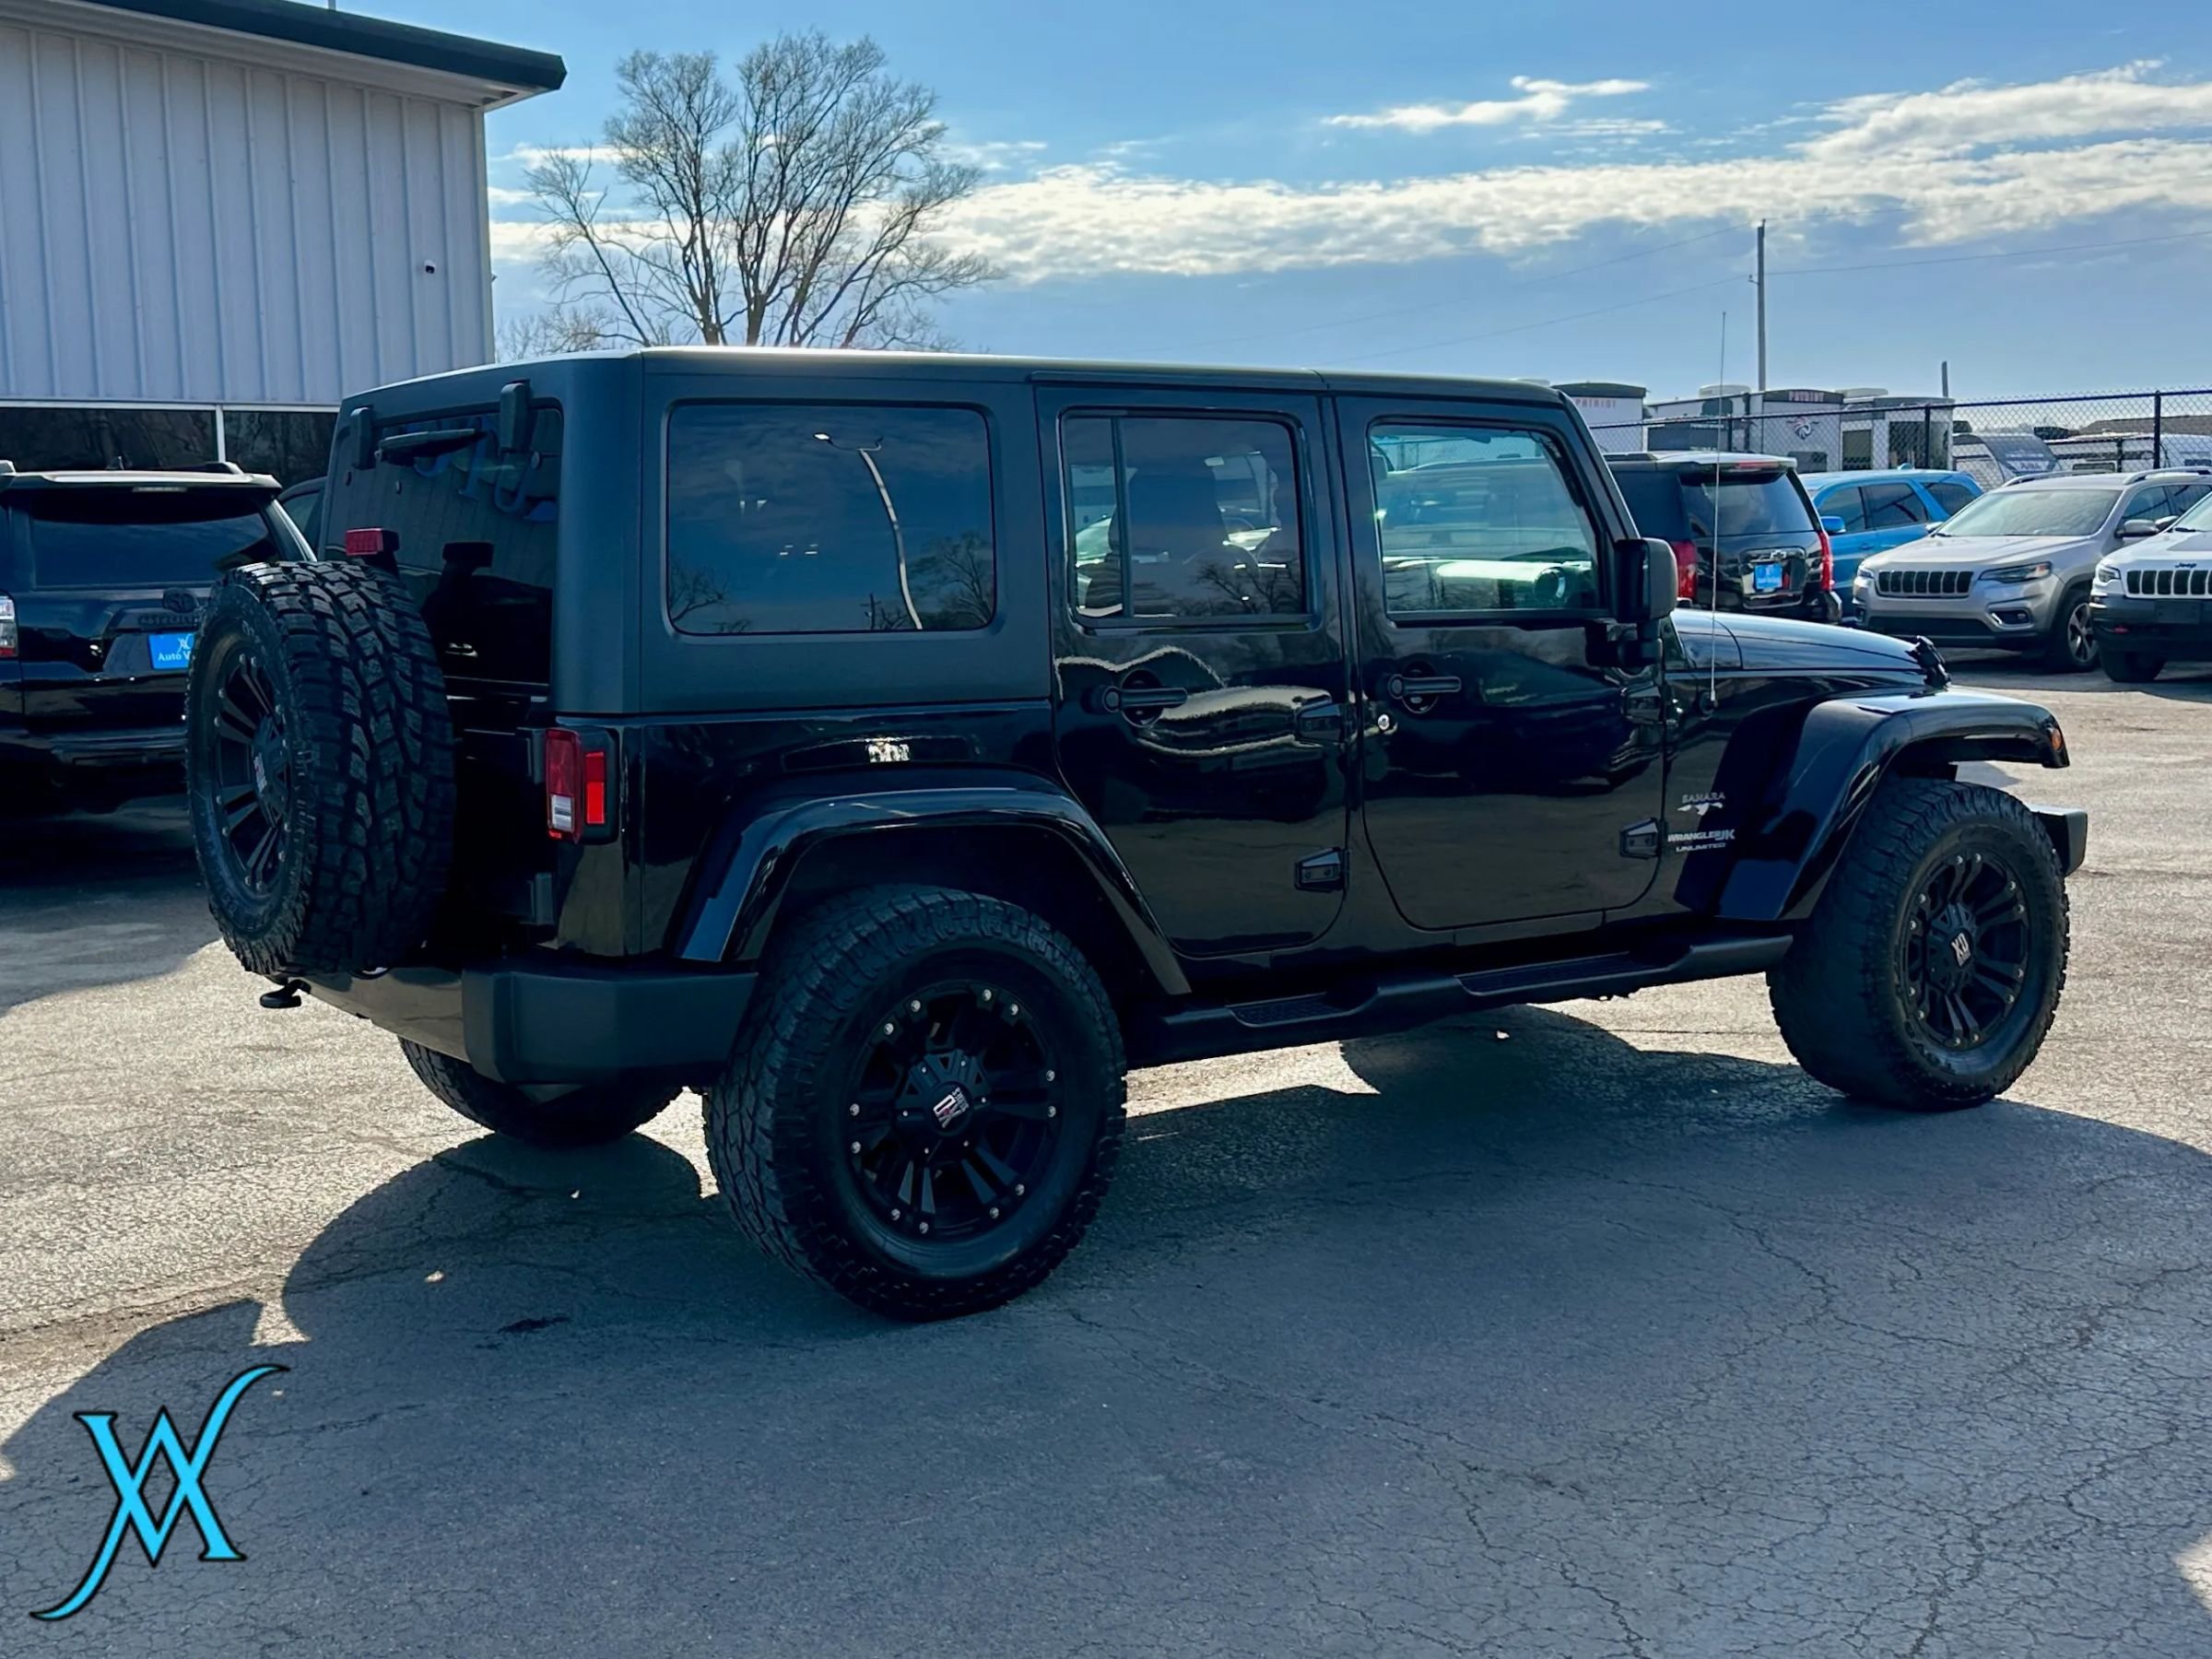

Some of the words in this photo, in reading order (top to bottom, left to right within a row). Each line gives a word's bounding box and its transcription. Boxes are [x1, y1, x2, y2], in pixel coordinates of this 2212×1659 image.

[1789, 391, 1825, 403] PATRIOT
[1575, 398, 1617, 408] PATRIOT
[158, 652, 182, 662] Auto
[1682, 792, 1726, 804] SAHARA
[1676, 842, 1726, 853] UNLIMITED
